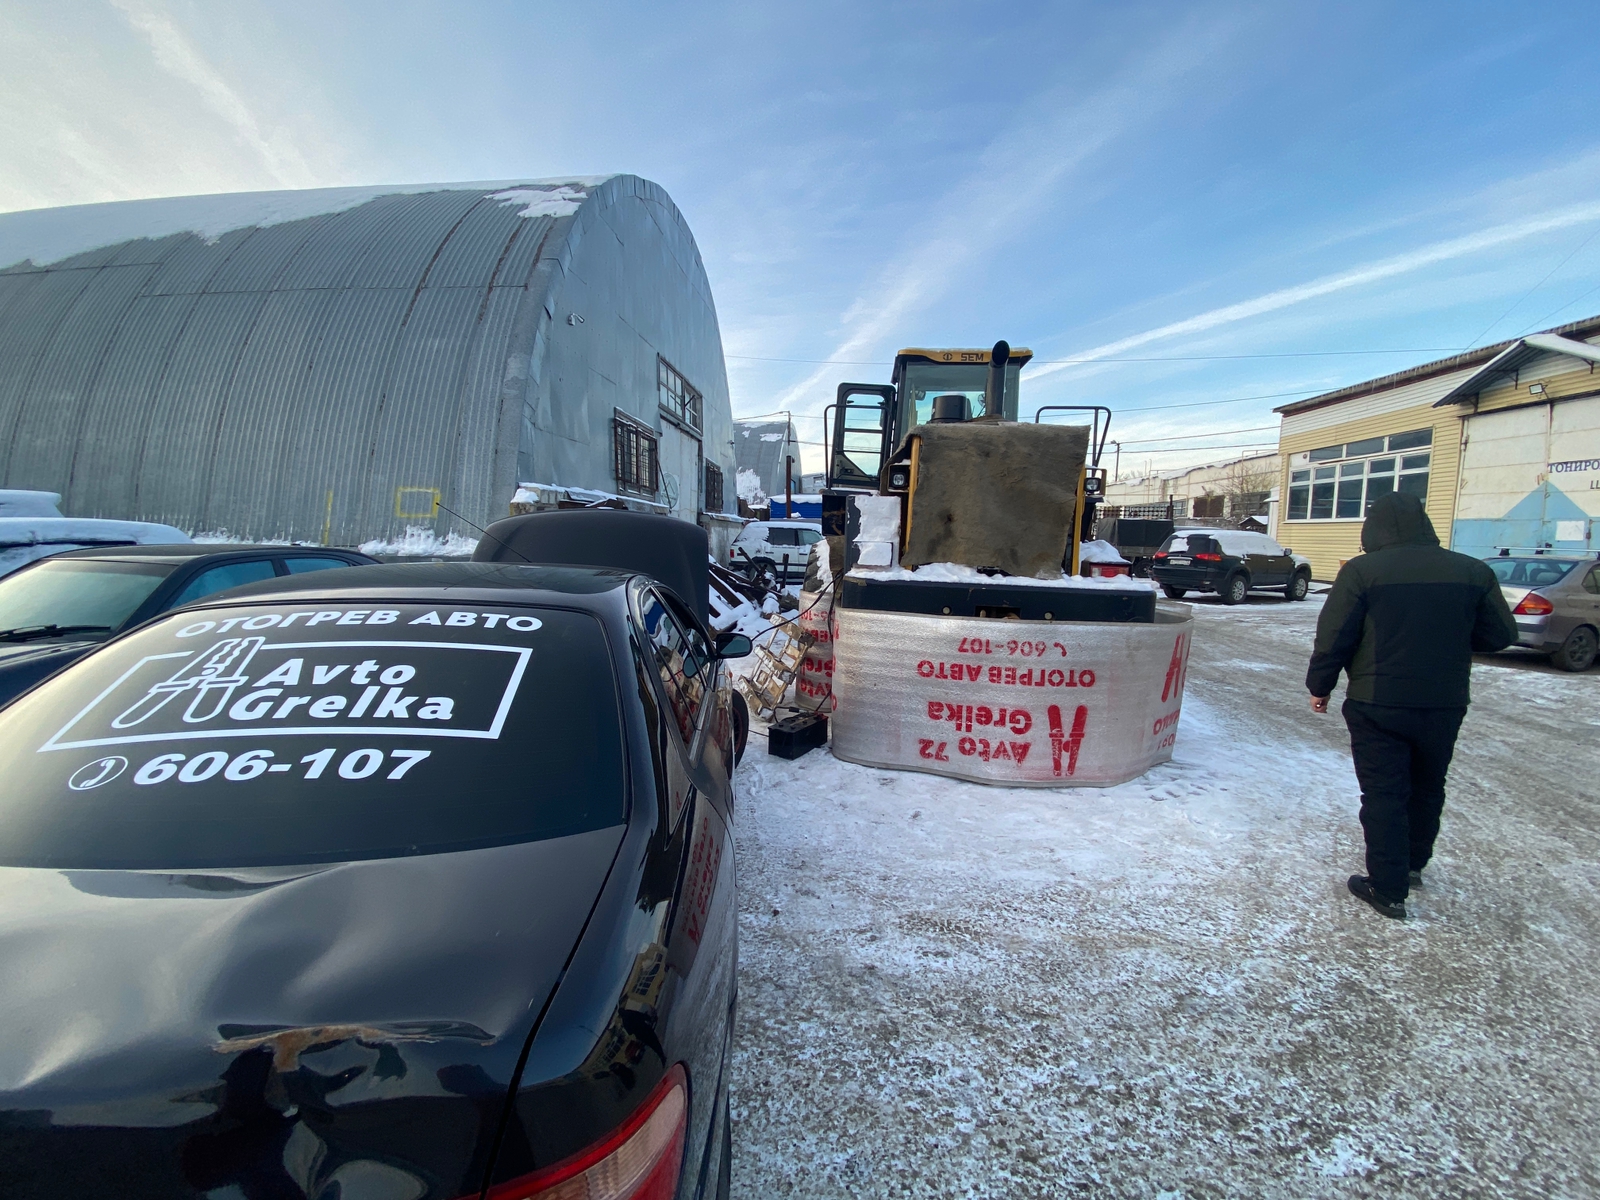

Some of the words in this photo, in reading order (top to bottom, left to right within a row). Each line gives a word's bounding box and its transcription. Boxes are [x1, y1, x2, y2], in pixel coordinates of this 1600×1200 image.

[961, 353, 984, 362] SEM
[175, 610, 400, 638] ОТОГРЕВ
[408, 612, 543, 632] АВТО
[957, 637, 1046, 657] 606-107
[253, 659, 416, 687] Avto
[917, 660, 983, 681] АВТО
[987, 667, 1096, 687] ОТОГРЕВ
[229, 686, 454, 721] Grelka
[928, 700, 1033, 735] Grelka
[918, 739, 949, 762] 72
[958, 738, 1031, 766] Avto
[134, 749, 431, 785] 606-107
